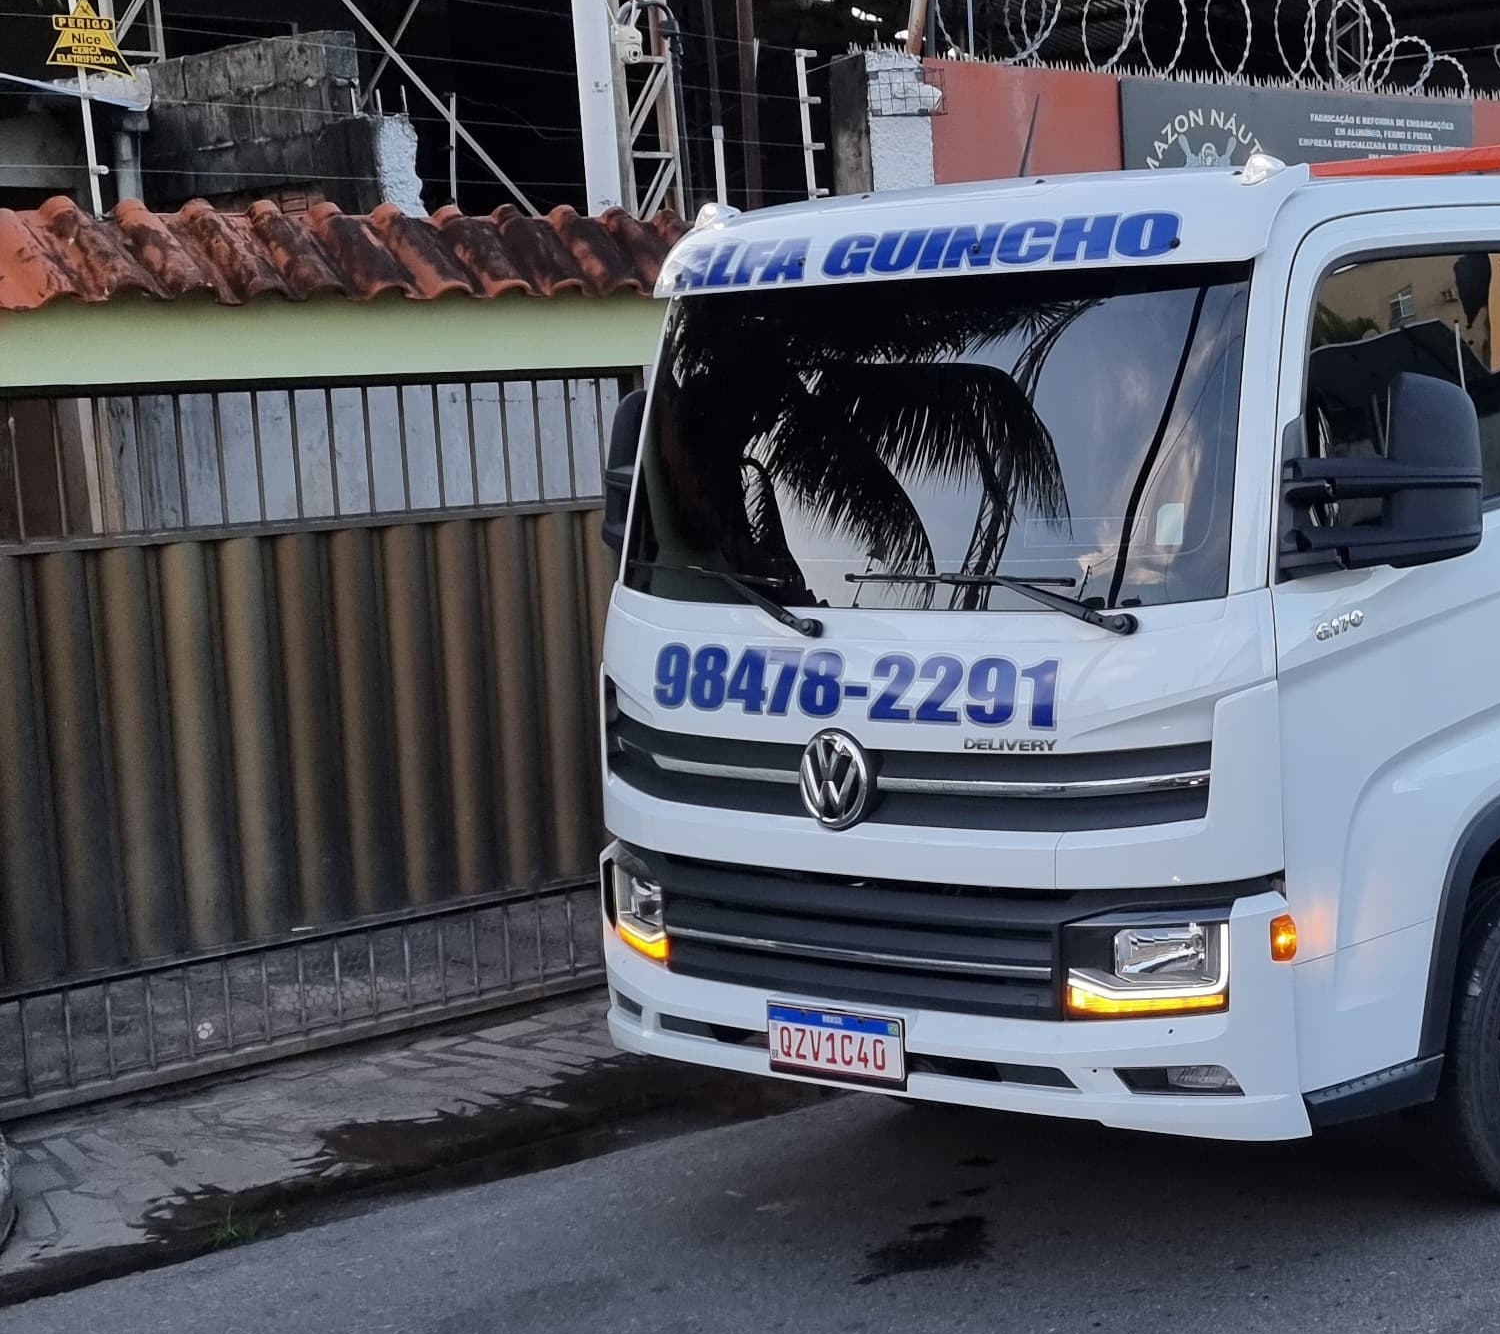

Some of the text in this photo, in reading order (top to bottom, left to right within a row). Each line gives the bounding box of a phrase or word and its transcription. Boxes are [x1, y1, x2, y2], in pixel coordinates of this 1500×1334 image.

[57, 17, 110, 30] PERIGO
[71, 32, 101, 45] Nice
[71, 46, 102, 56] CERCA
[56, 54, 118, 65] ELETRIFICADA
[1210, 109, 1263, 154] NÁUT
[672, 210, 1183, 292] ALFA GUINCHO
[653, 642, 1063, 732] 98478-2291
[963, 737, 1058, 752] DELIVERY
[779, 1026, 886, 1071] QZV1C40
